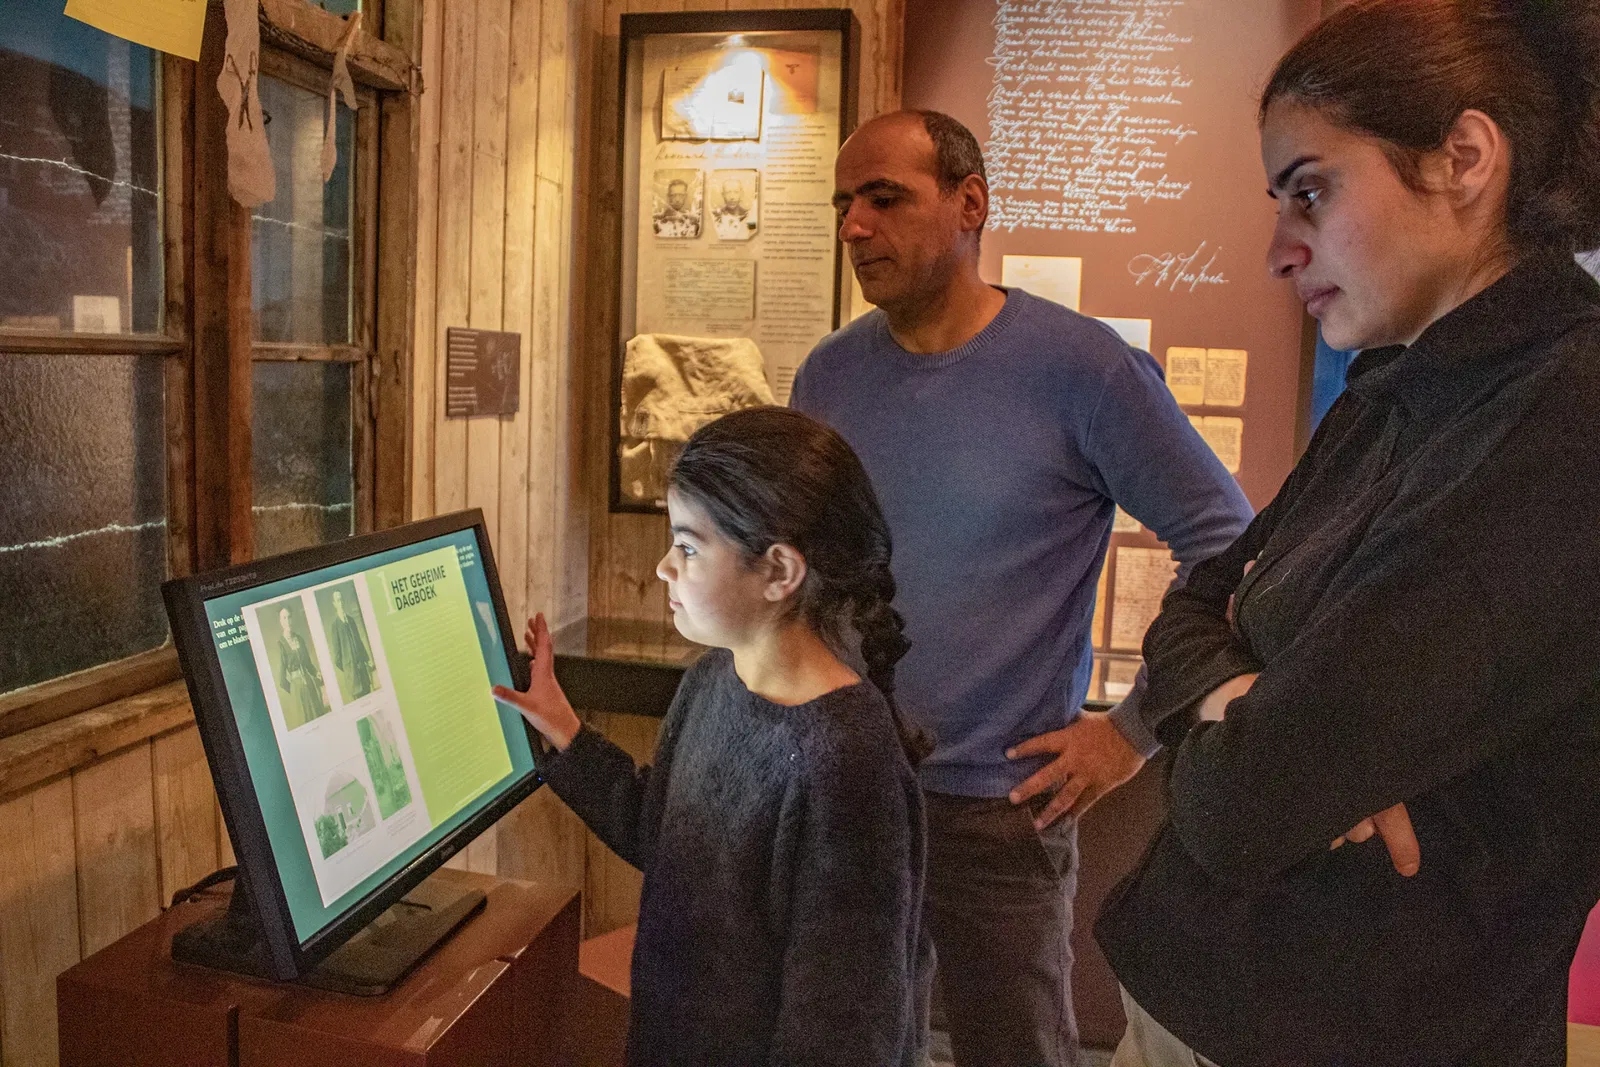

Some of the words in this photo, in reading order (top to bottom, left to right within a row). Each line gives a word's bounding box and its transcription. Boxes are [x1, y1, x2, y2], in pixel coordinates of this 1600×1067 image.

[390, 577, 409, 594] HET
[409, 565, 447, 589] GEHEIME
[395, 584, 438, 611] DAGBOEK
